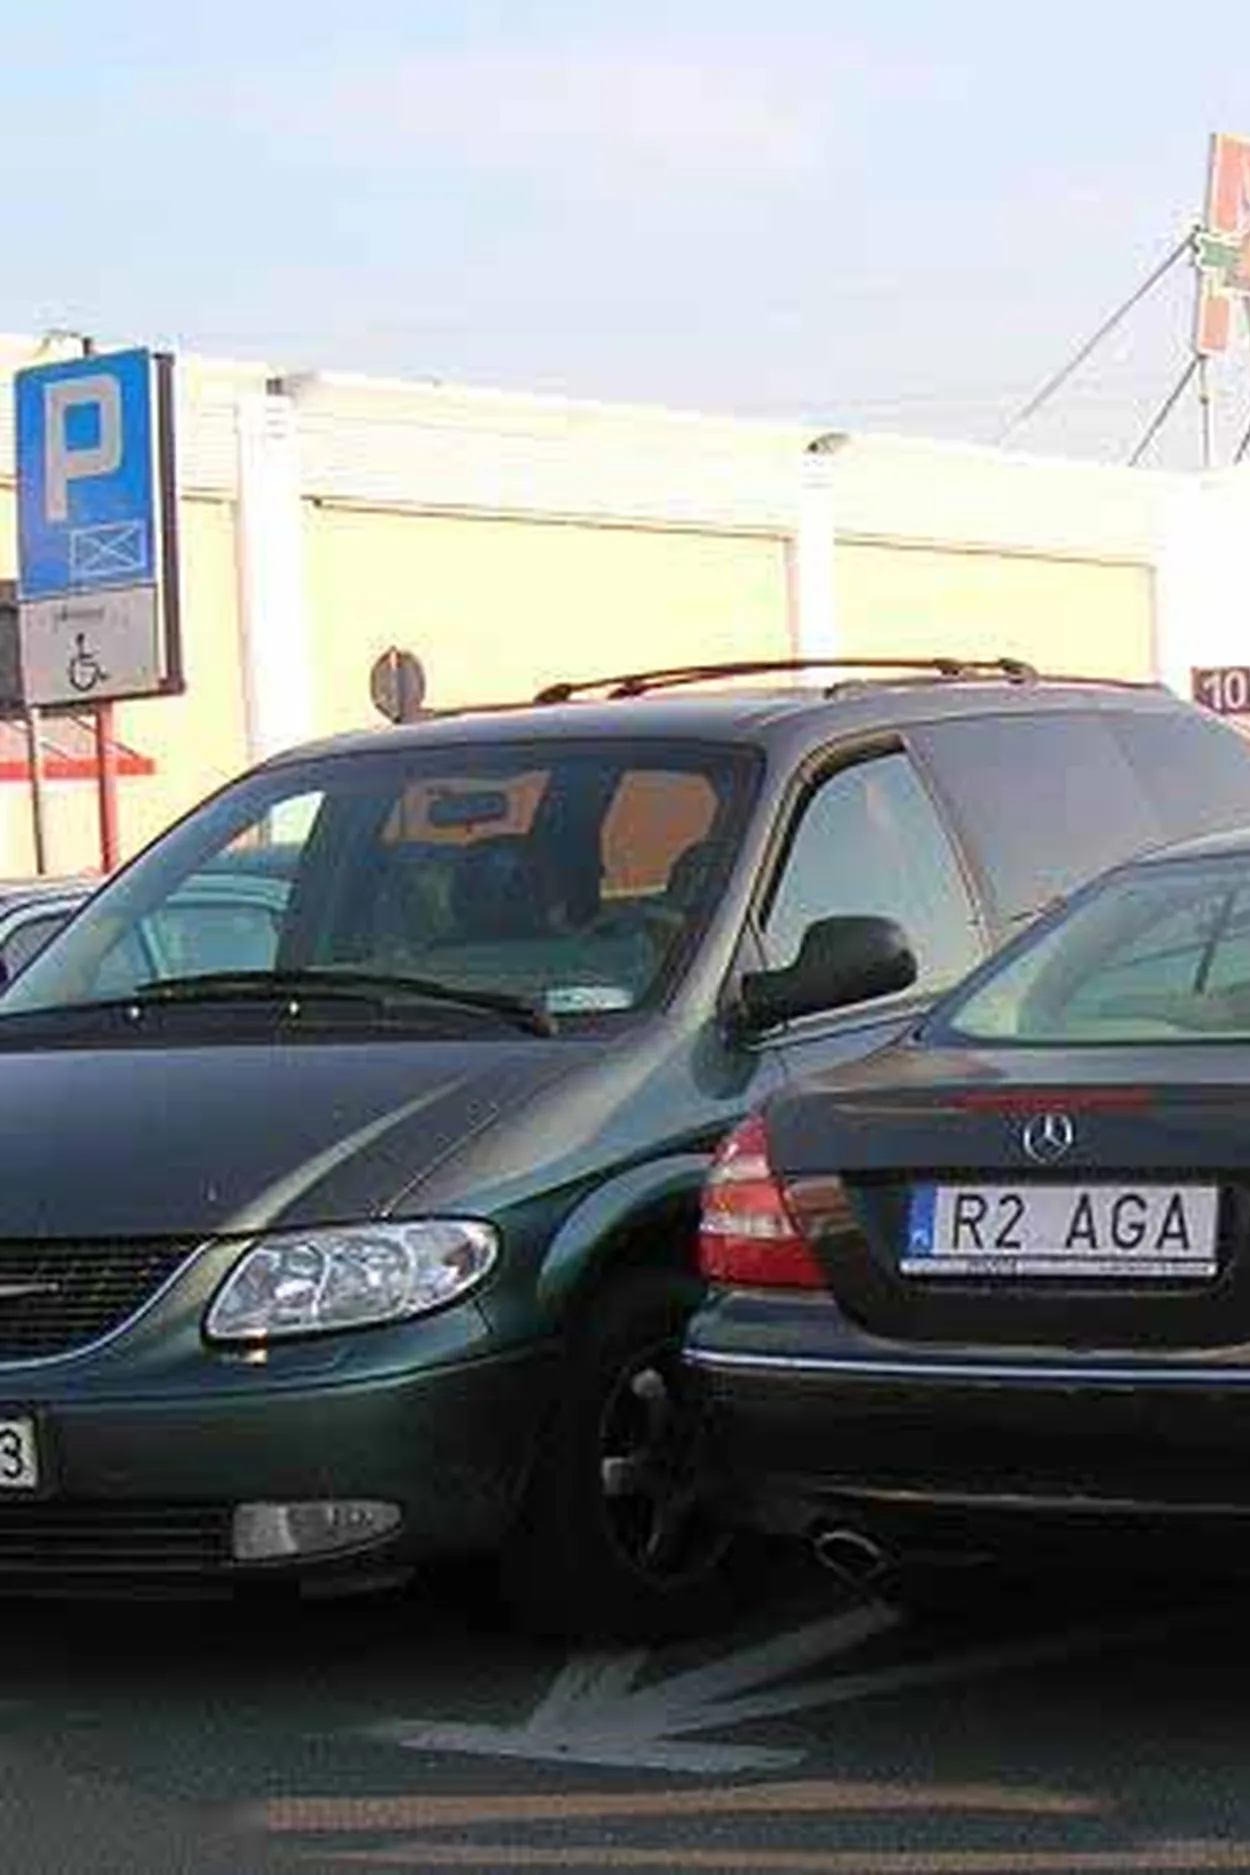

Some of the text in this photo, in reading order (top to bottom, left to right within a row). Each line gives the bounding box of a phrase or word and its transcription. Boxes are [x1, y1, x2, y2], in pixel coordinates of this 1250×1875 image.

[45, 374, 122, 524] P
[1203, 669, 1247, 710] 10
[952, 1193, 1026, 1251] R2
[1065, 1192, 1190, 1251] AGA
